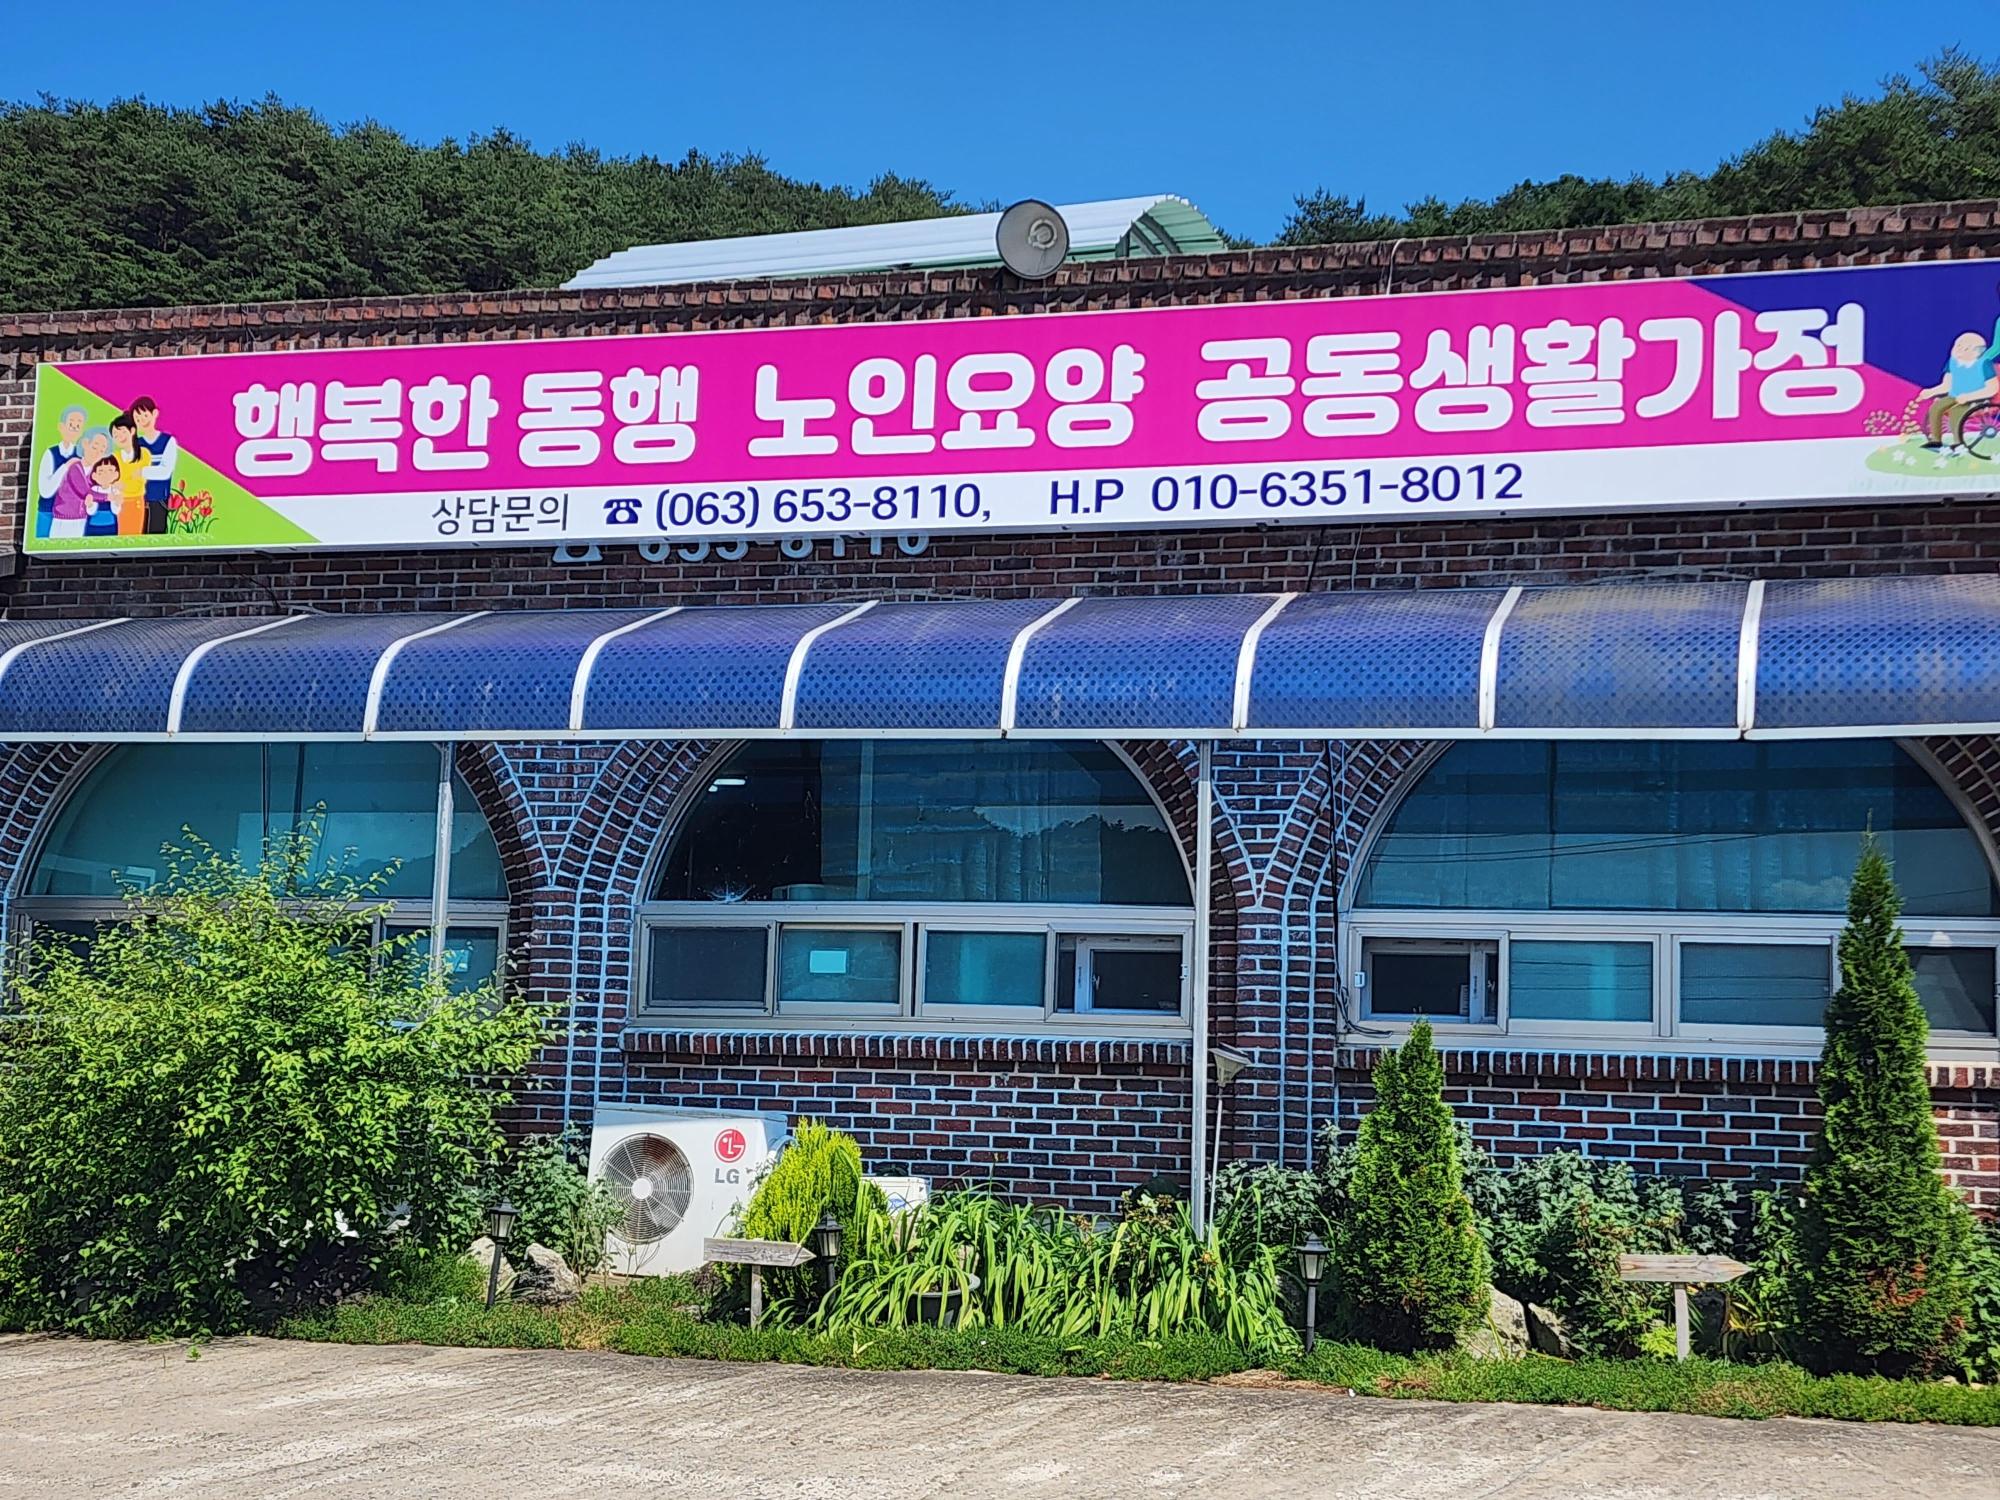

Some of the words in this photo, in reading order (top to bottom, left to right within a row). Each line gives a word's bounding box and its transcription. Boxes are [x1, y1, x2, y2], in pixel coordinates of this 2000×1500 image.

[232, 374, 499, 478] 행복한
[517, 365, 699, 467] 동행
[748, 344, 1145, 457] 노인요양
[1195, 303, 1865, 442] 공동생활가정
[432, 493, 570, 536] 상담문의
[656, 486, 760, 531] (063)
[1050, 478, 1124, 515] H.P
[1151, 463, 1523, 512] 010-6351-8012
[714, 1167, 740, 1185] LG
